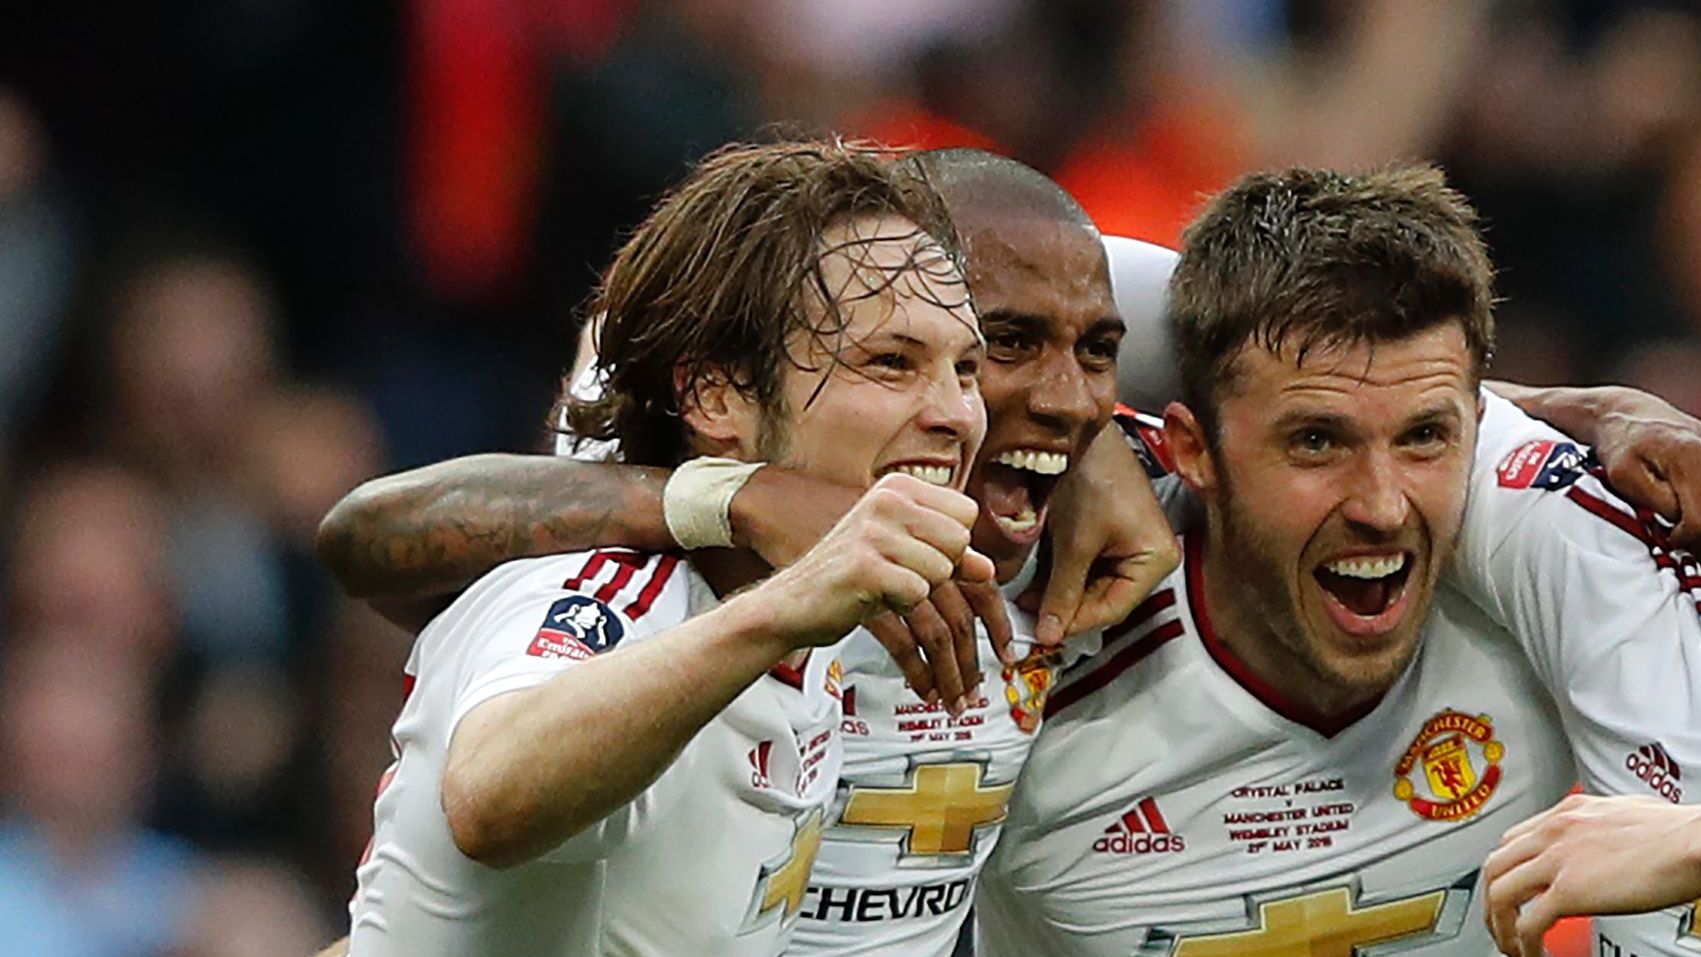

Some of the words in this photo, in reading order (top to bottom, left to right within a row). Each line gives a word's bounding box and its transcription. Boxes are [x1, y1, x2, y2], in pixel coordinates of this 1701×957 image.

[1231, 786, 1290, 798] CRYSTAL
[1295, 778, 1345, 795] PALACE
[1625, 752, 1682, 804] adidas
[1224, 809, 1307, 824] MANCHESTER
[1312, 803, 1355, 818] UNITED
[1230, 826, 1289, 841] WEMBLEY
[1296, 820, 1349, 836] STADIUM
[1092, 830, 1186, 854] adidas
[1273, 839, 1300, 852] MAY
[800, 878, 970, 922] CHEVRO
